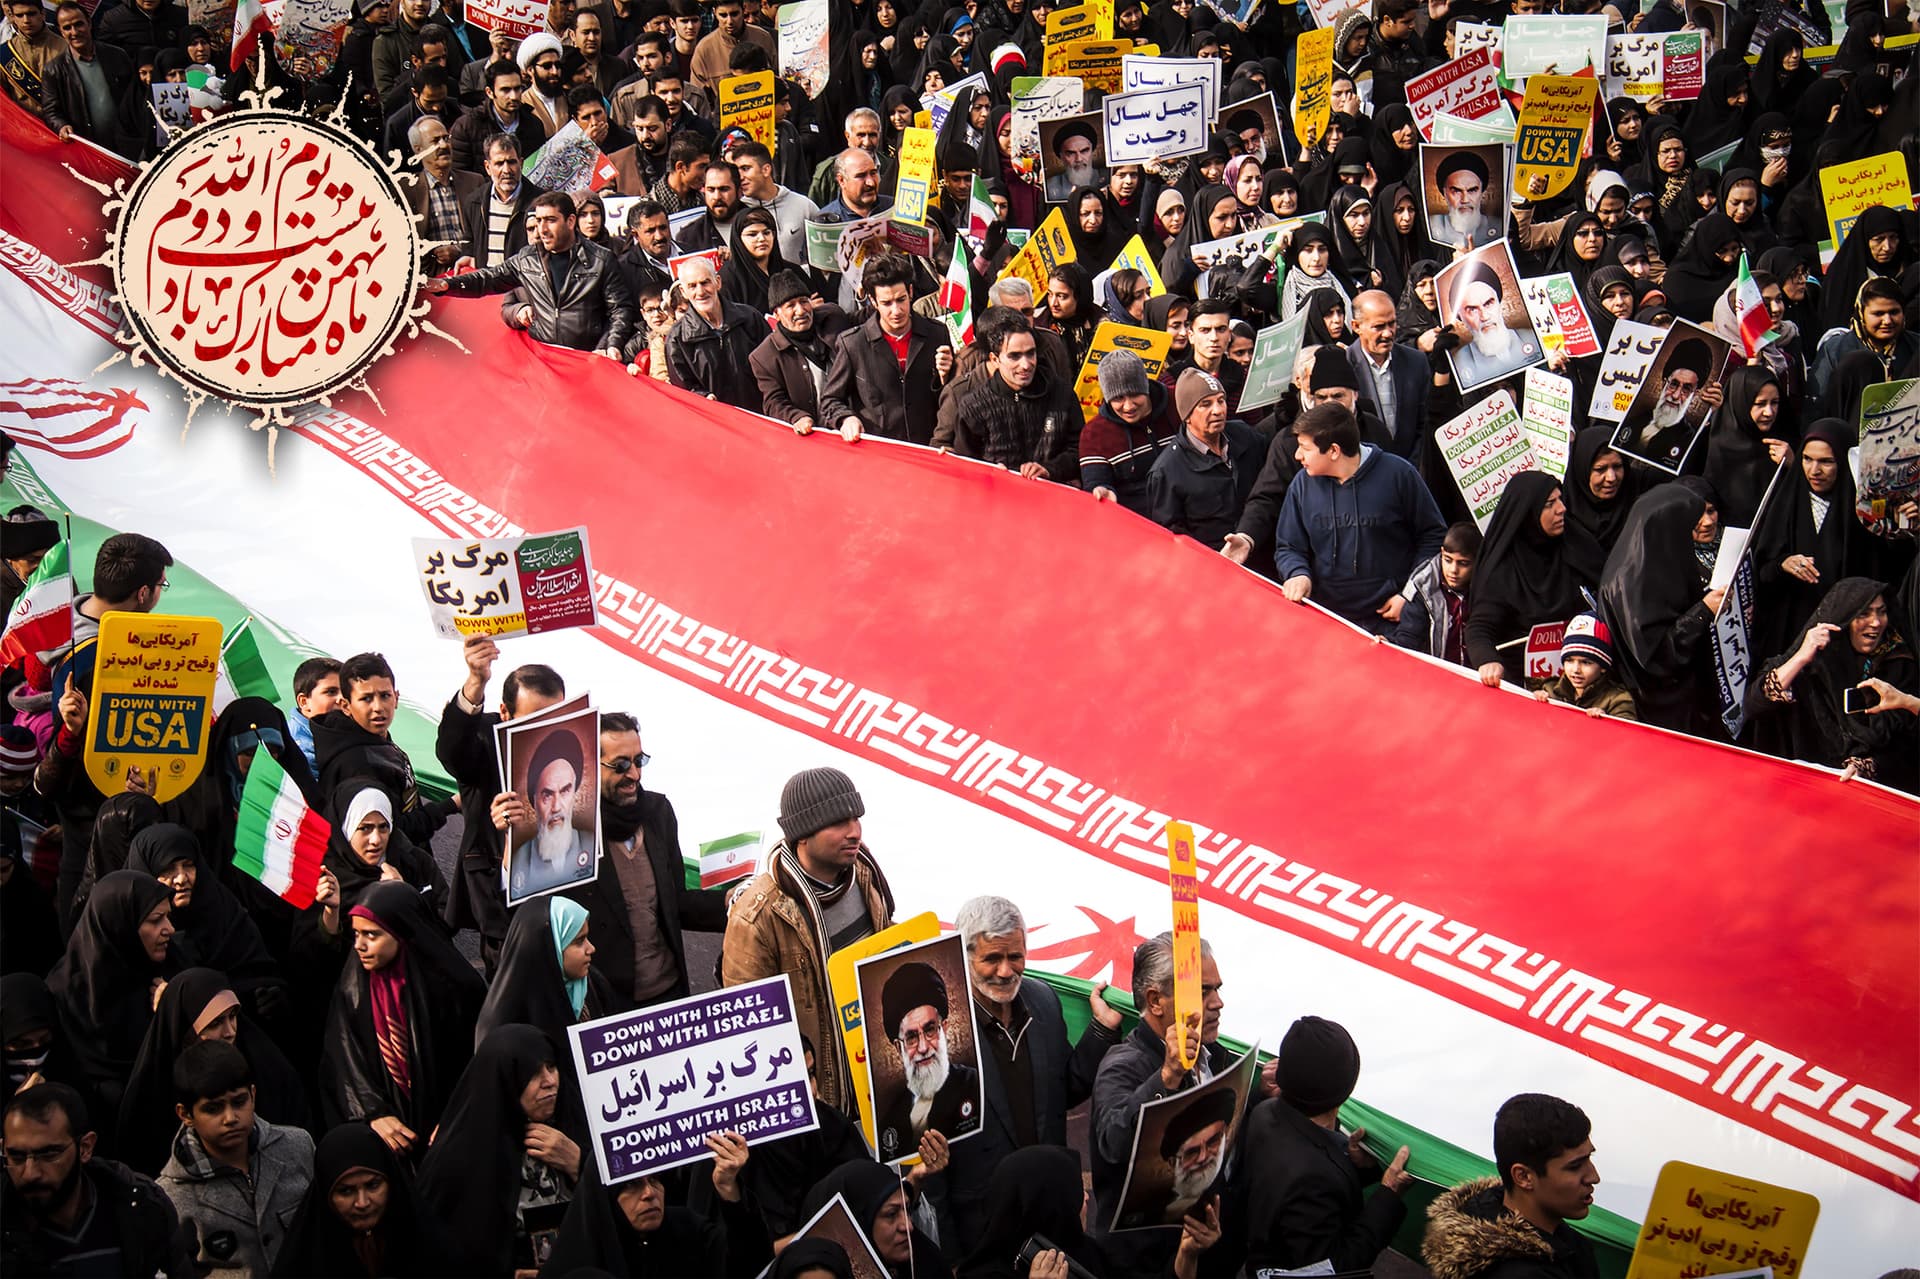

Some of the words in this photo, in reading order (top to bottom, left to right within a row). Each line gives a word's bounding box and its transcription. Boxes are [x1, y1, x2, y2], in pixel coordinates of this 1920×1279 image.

[1609, 42, 1623, 58] بر
[1627, 36, 1659, 57] مرگ
[1129, 71, 1165, 88] سال
[1411, 79, 1434, 98] DOWN
[1436, 66, 1458, 85] WITH
[1464, 75, 1494, 94] مرگ
[1455, 87, 1464, 106] بر
[1110, 105, 1150, 126] سال
[1156, 101, 1198, 122] چهل
[1125, 129, 1186, 145] وحدت
[1526, 129, 1552, 137] DOWN
[1555, 130, 1578, 138] WITH
[1521, 137, 1570, 163] USA
[1609, 335, 1632, 355] بر
[1486, 400, 1504, 416] مرگ
[1477, 412, 1486, 426] بر
[1493, 424, 1520, 448] الموت
[1448, 438, 1473, 458] DOWN
[1461, 468, 1485, 487] DOWN
[424, 551, 445, 575] بر
[452, 544, 509, 576] مرگ
[427, 579, 509, 616] امریکا
[454, 618, 491, 628] DOWN
[493, 614, 525, 626] WITH
[102, 653, 116, 669] تر
[118, 654, 143, 668] ادب
[144, 657, 161, 670] بی
[163, 659, 171, 671] و
[173, 655, 186, 671] تر
[187, 655, 215, 672] وقیح
[133, 675, 151, 688] اند
[152, 677, 179, 688] شده
[110, 698, 154, 709] DOWN
[160, 699, 196, 710] WITH
[106, 710, 190, 748] USA
[603, 1020, 655, 1044] DOWN
[659, 1008, 701, 1030] WITH
[706, 993, 765, 1018] ISRAEL
[591, 1038, 653, 1067] DOWN
[657, 1024, 708, 1048] WITH
[713, 1006, 784, 1034] ISRAEL
[731, 1040, 793, 1082] مرگ
[703, 1060, 727, 1098] بر
[602, 1057, 697, 1122] اسرائیل
[610, 1122, 671, 1151] DOWN
[676, 1104, 729, 1132] WITH
[734, 1089, 802, 1118] ISRAEL
[631, 1140, 682, 1165] DOWN
[733, 1112, 790, 1137] ISRAEL
[1644, 1217, 1668, 1241] تر
[1667, 1225, 1702, 1246] ادب
[1700, 1238, 1726, 1257] بی
[1724, 1243, 1737, 1261] و
[1737, 1240, 1760, 1264] تر
